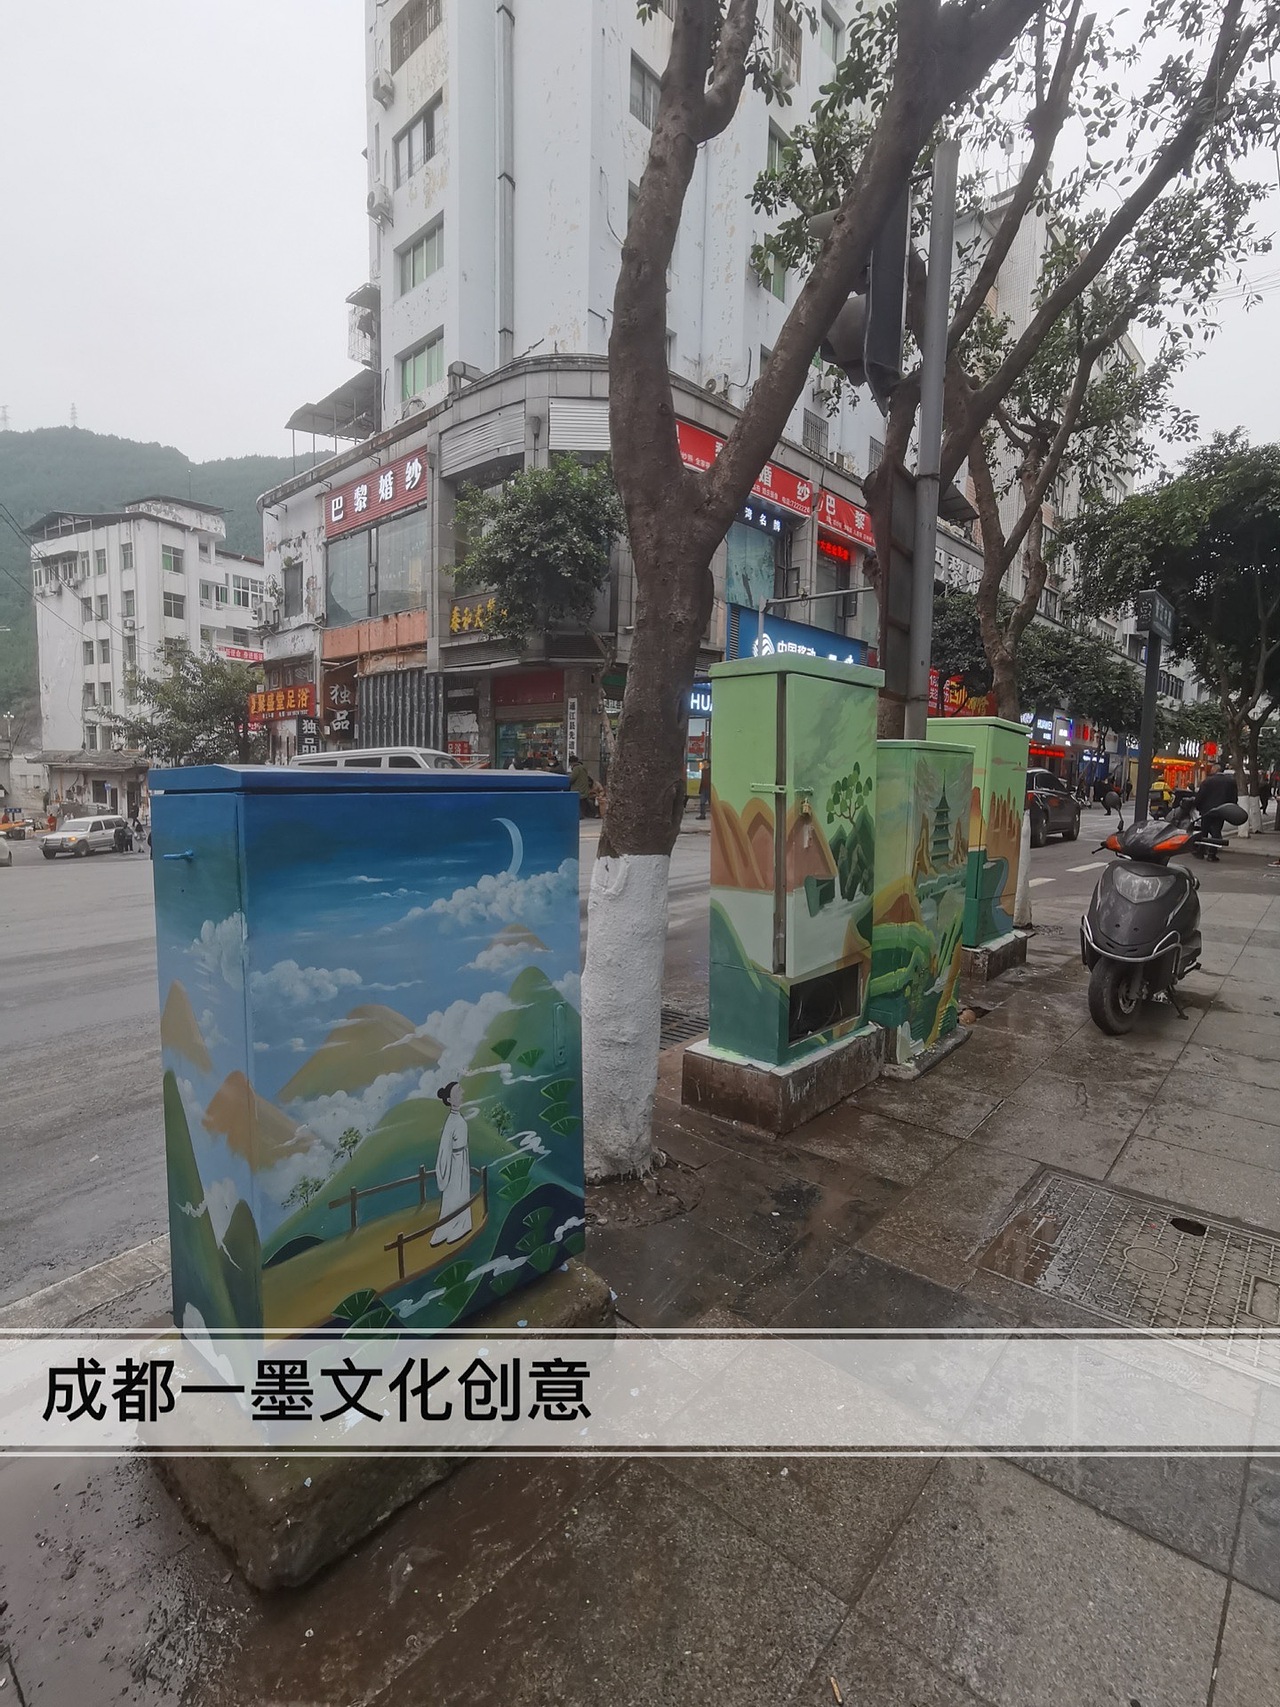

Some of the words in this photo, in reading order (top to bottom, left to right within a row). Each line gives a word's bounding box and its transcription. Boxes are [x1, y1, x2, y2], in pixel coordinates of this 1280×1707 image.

[331, 458, 423, 523] 巴黎婚纱
[826, 494, 866, 531] 巴黎
[329, 684, 351, 732] 独品
[690, 691, 713, 711] HU
[302, 719, 317, 754] 独品
